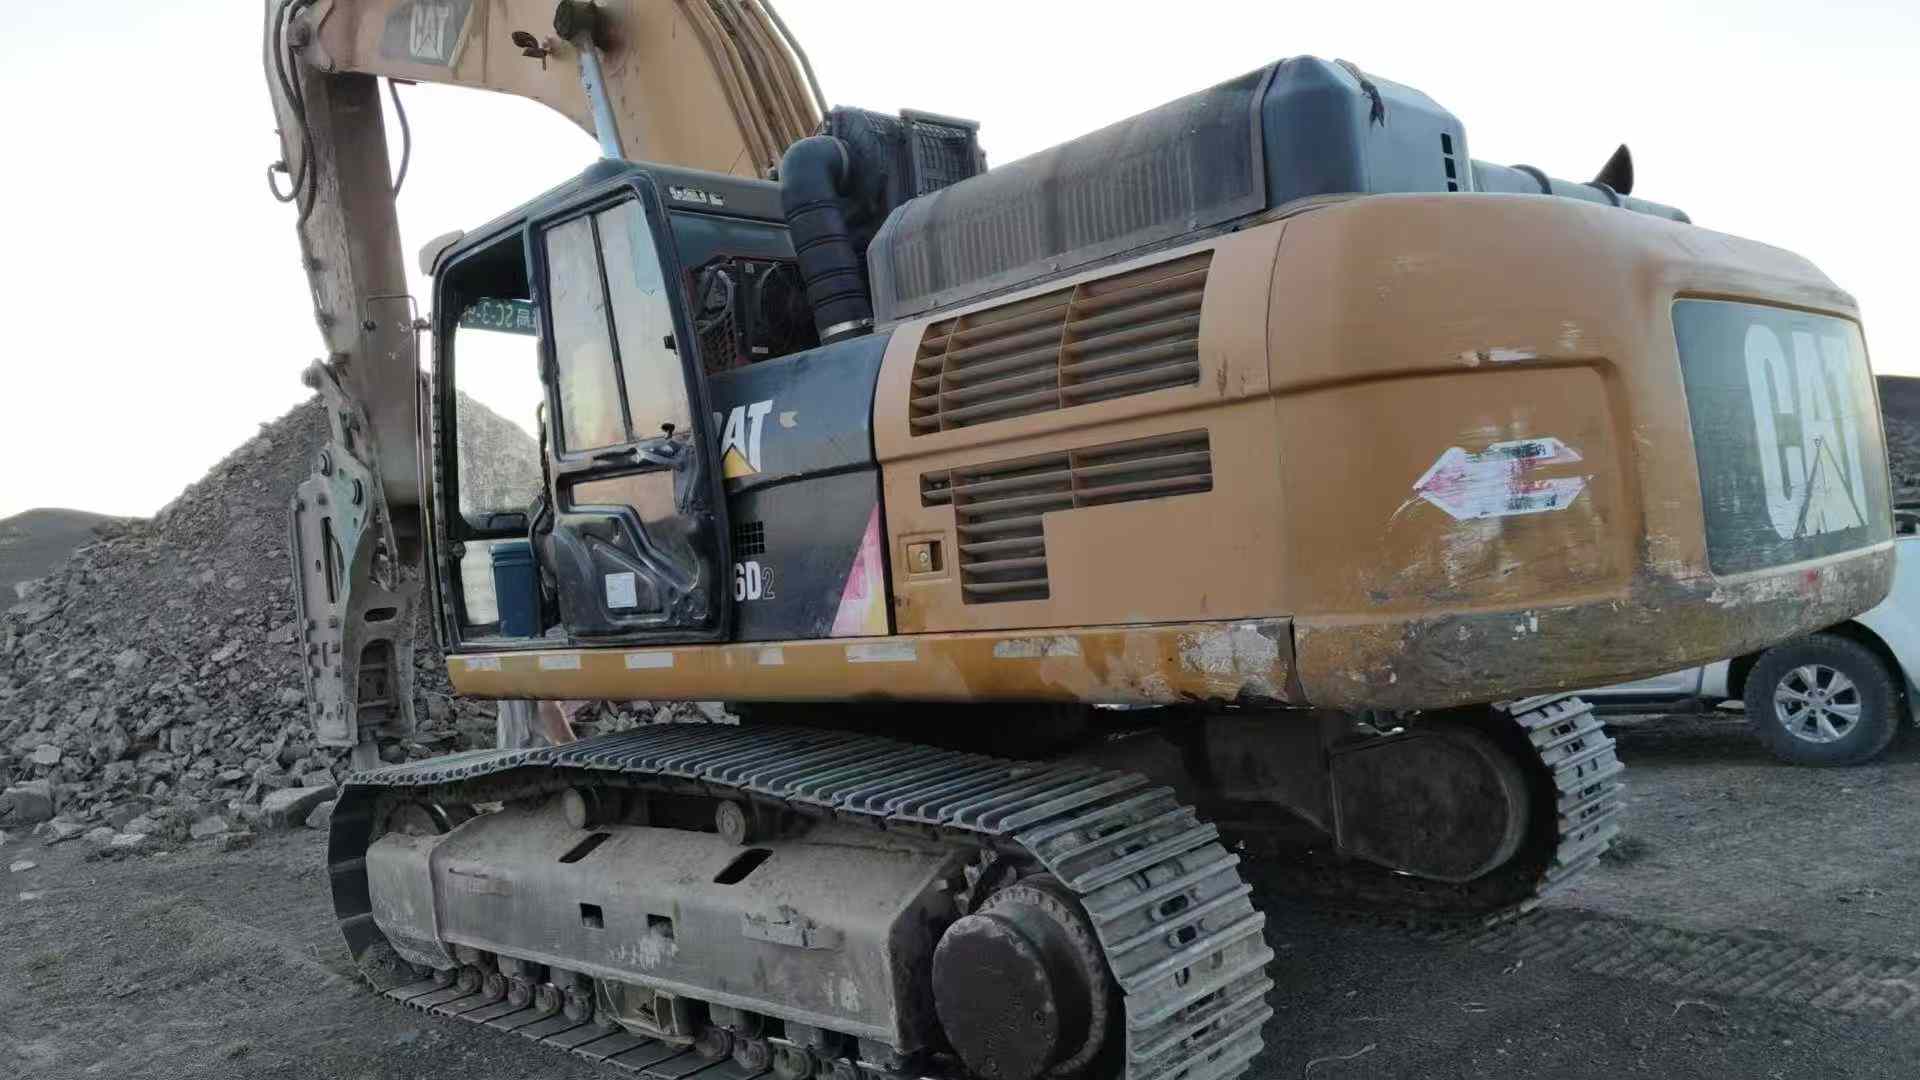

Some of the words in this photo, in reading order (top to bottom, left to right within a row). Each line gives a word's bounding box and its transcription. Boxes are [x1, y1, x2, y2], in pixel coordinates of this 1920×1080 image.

[409, 2, 449, 59] CAT
[712, 400, 773, 473] AT
[1743, 323, 1868, 540] CAT
